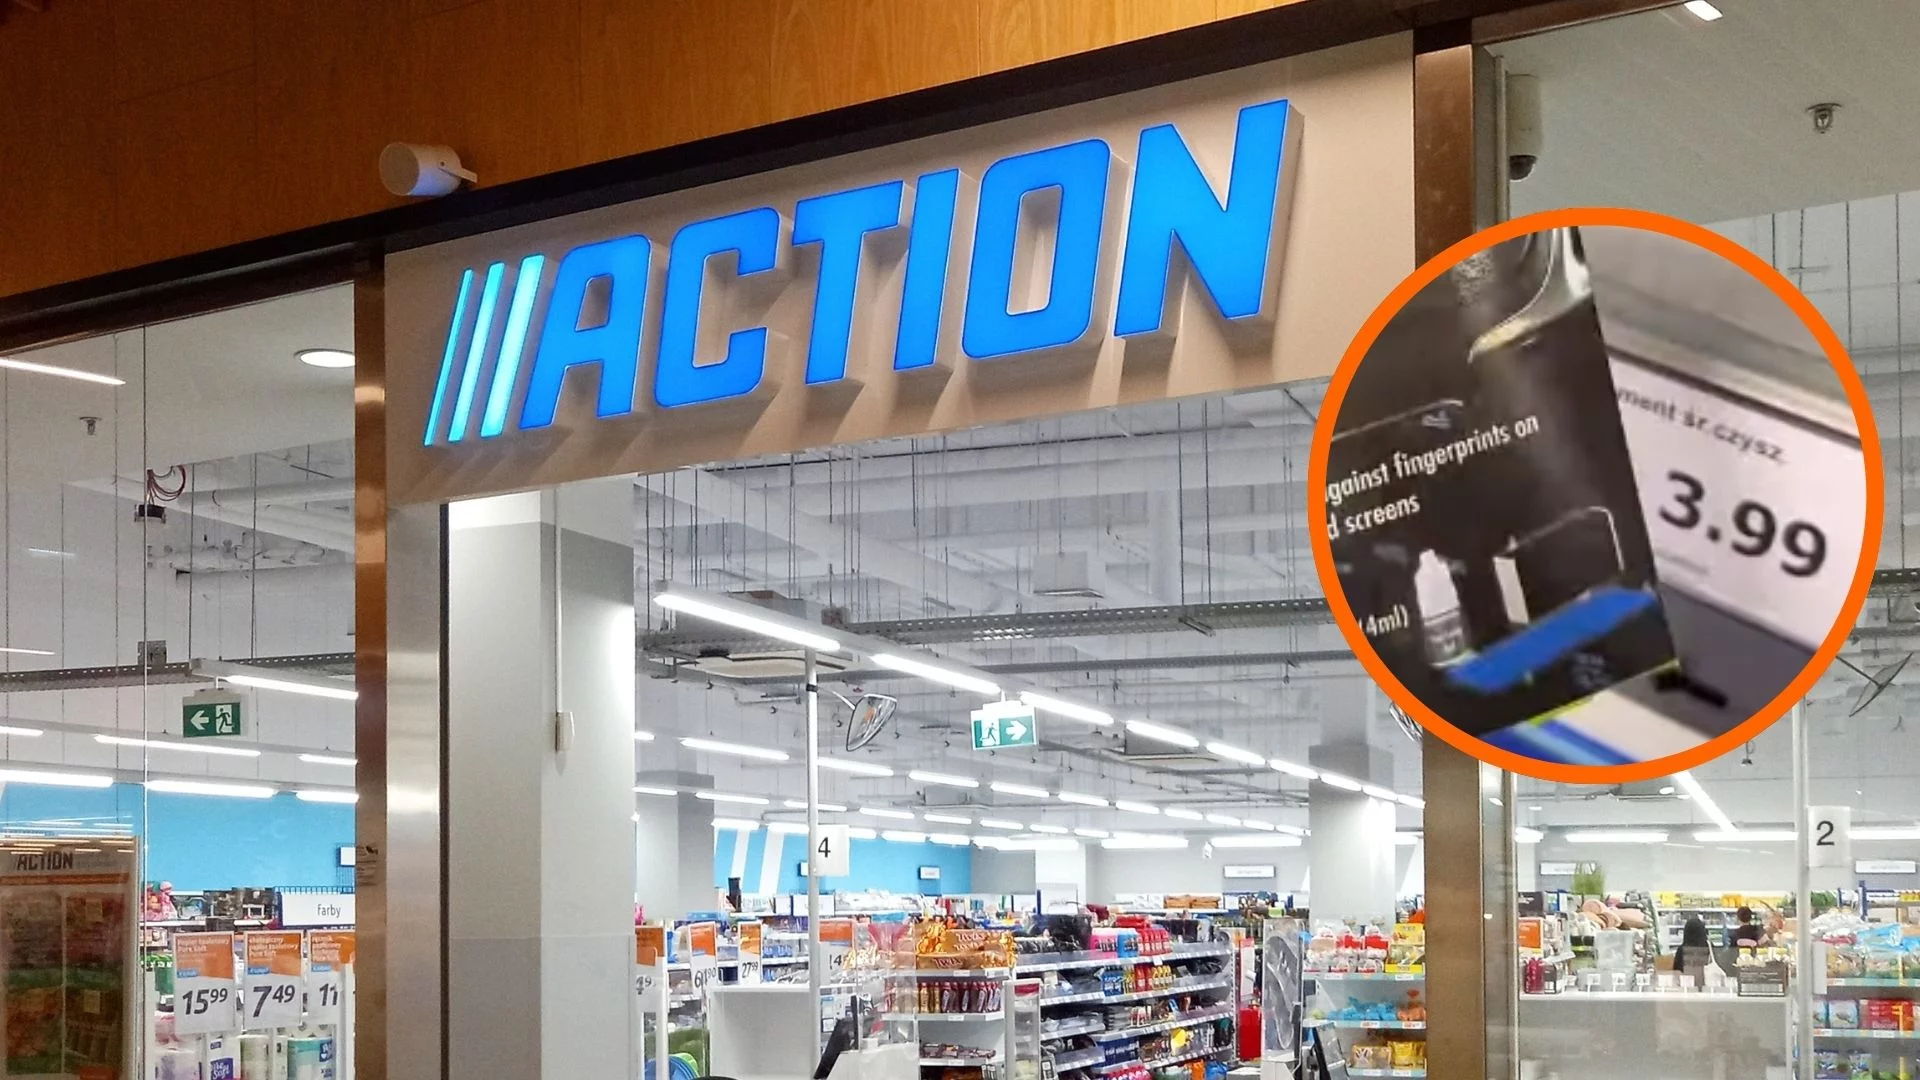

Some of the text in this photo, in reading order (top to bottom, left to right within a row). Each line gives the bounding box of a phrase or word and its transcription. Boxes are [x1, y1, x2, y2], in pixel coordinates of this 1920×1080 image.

[519, 98, 1291, 430] ACTION
[1393, 424, 1511, 476] fingerprints
[1514, 414, 1540, 438] on
[1344, 493, 1421, 535] screens
[1658, 468, 1828, 578] 3.99
[817, 836, 831, 858] 4
[1815, 820, 1835, 846] 2
[17, 851, 73, 870] ACTION
